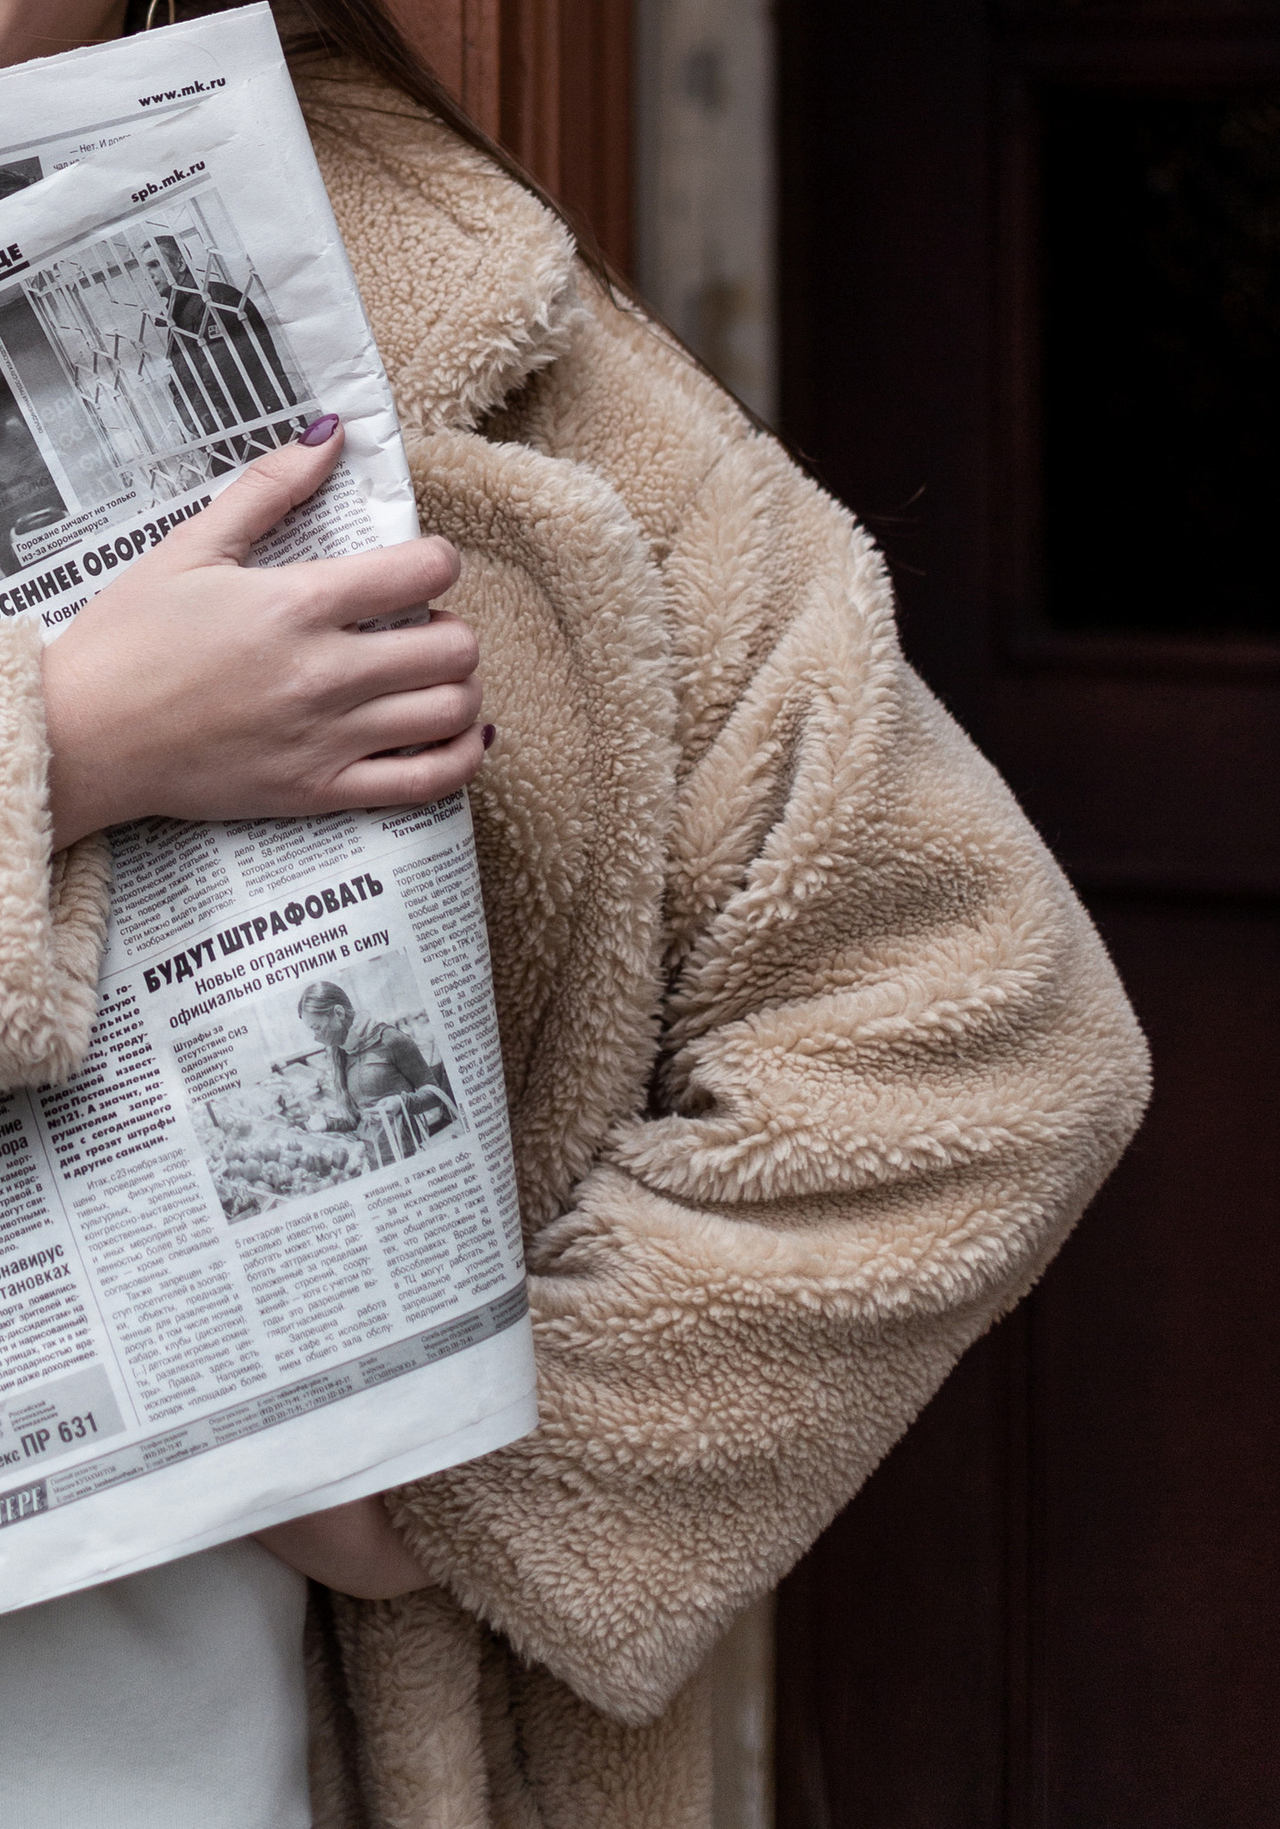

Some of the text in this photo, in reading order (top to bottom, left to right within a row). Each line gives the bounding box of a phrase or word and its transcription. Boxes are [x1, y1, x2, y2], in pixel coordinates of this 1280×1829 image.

[138, 77, 226, 106] www.mk.ru
[130, 160, 205, 202] spb.mk.ru
[15, 490, 136, 552] Горожане дичают не только
[21, 516, 109, 562] из-за коронавируса
[381, 803, 437, 831] Александр
[392, 819, 433, 839] Татьяна
[142, 872, 383, 993] БУДУТ ШТРАФОВАТЬ
[194, 923, 348, 995] Новые ограничения
[169, 929, 389, 1028] официально вступили в силу
[172, 1025, 223, 1053] Штрафы за
[177, 1025, 248, 1063] отсутствие СИЗ
[180, 1045, 234, 1073] однозначно
[184, 1059, 227, 1084] поднимут
[69, 1068, 160, 1107] Постановления
[187, 1068, 237, 1094] городскую
[191, 1079, 241, 1103] экономику
[85, 1116, 175, 1157] грозят штрафы
[5, 1154, 32, 1169] мерт-
[73, 1135, 168, 1178] другие санкции.
[20, 1428, 50, 1457] ПР
[57, 1411, 97, 1443] 631
